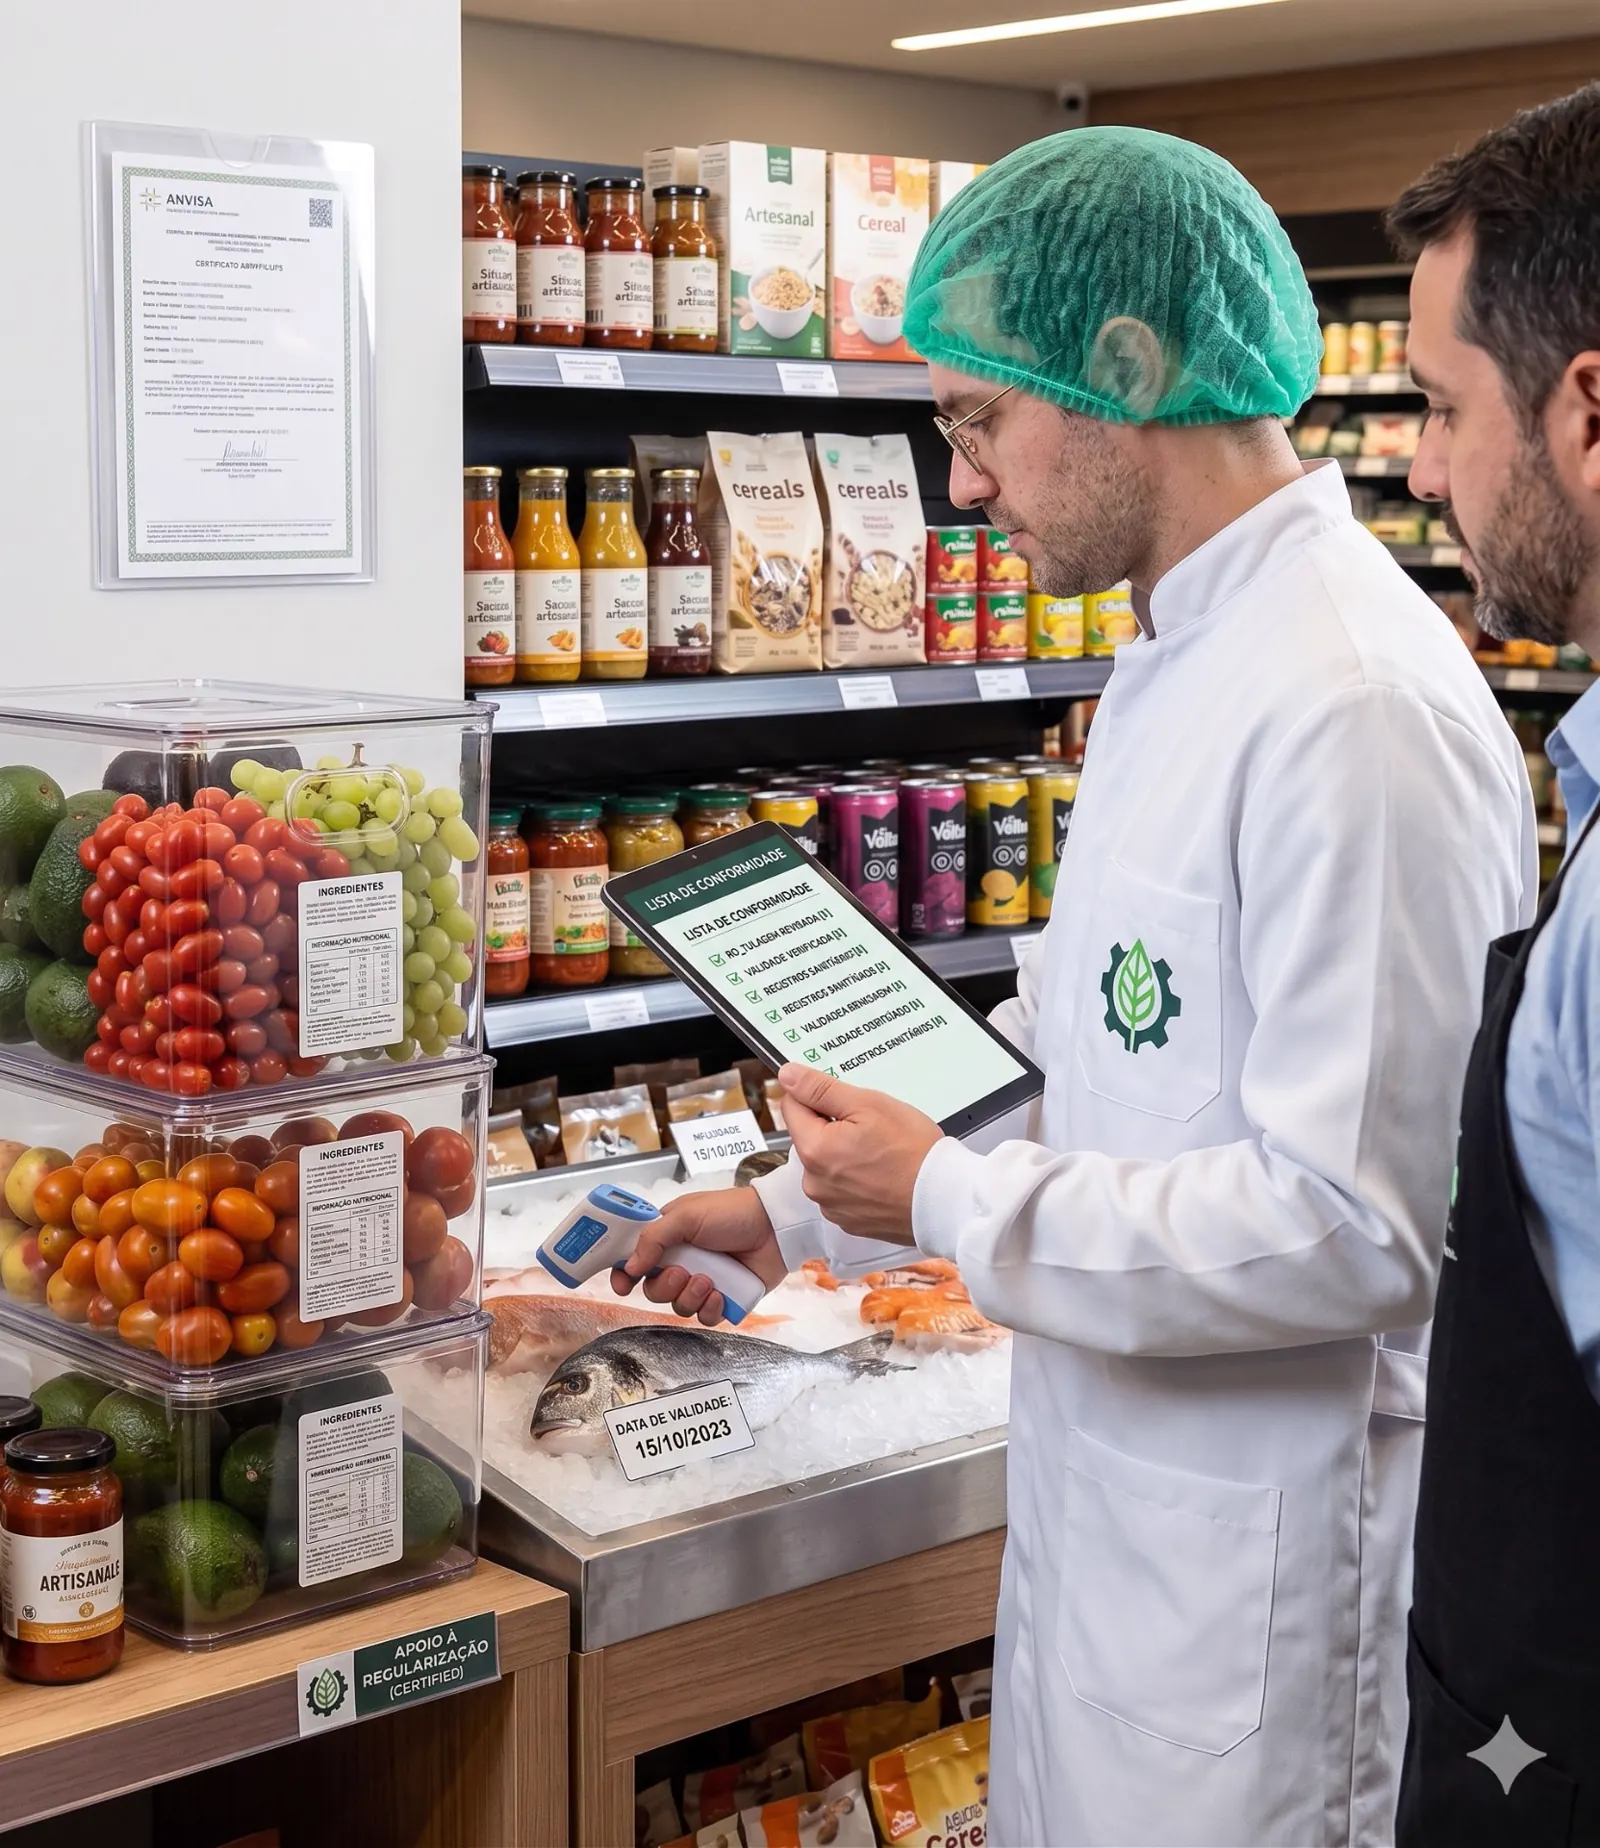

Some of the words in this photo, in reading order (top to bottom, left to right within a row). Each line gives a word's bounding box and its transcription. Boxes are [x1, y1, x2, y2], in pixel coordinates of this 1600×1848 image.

[166, 193, 214, 208] ANVISA
[744, 207, 815, 228] Artesanal
[858, 214, 906, 233] Cereal
[732, 479, 805, 500] cereals
[838, 479, 909, 499] cereals
[318, 881, 384, 897] INGREDIENTES
[644, 891, 682, 911] LISTA
[678, 883, 699, 898] DE
[696, 848, 787, 890] CONFORMIDADE
[683, 922, 717, 941] LISTA
[713, 915, 732, 930] DE
[730, 882, 813, 922] CONFORMIDADE
[743, 953, 788, 977] VALIDADE
[820, 1026, 864, 1053] VALIDADE
[319, 1141, 385, 1161] INGREDIENTES
[693, 1140, 756, 1161] 15/10/2023
[319, 1404, 383, 1427] INGREDIENTES
[615, 1418, 649, 1436] DATA
[648, 1412, 668, 1427] DE
[668, 1395, 733, 1421] VALIDADE:
[635, 1418, 732, 1459] 15/10/2023
[40, 1558, 120, 1592] ARTISANALE
[394, 1634, 443, 1660] APOIO
[446, 1628, 458, 1646] À
[362, 1639, 489, 1689] REGULARIZAÇÃO
[389, 1665, 465, 1701] (CERTIFIED)
